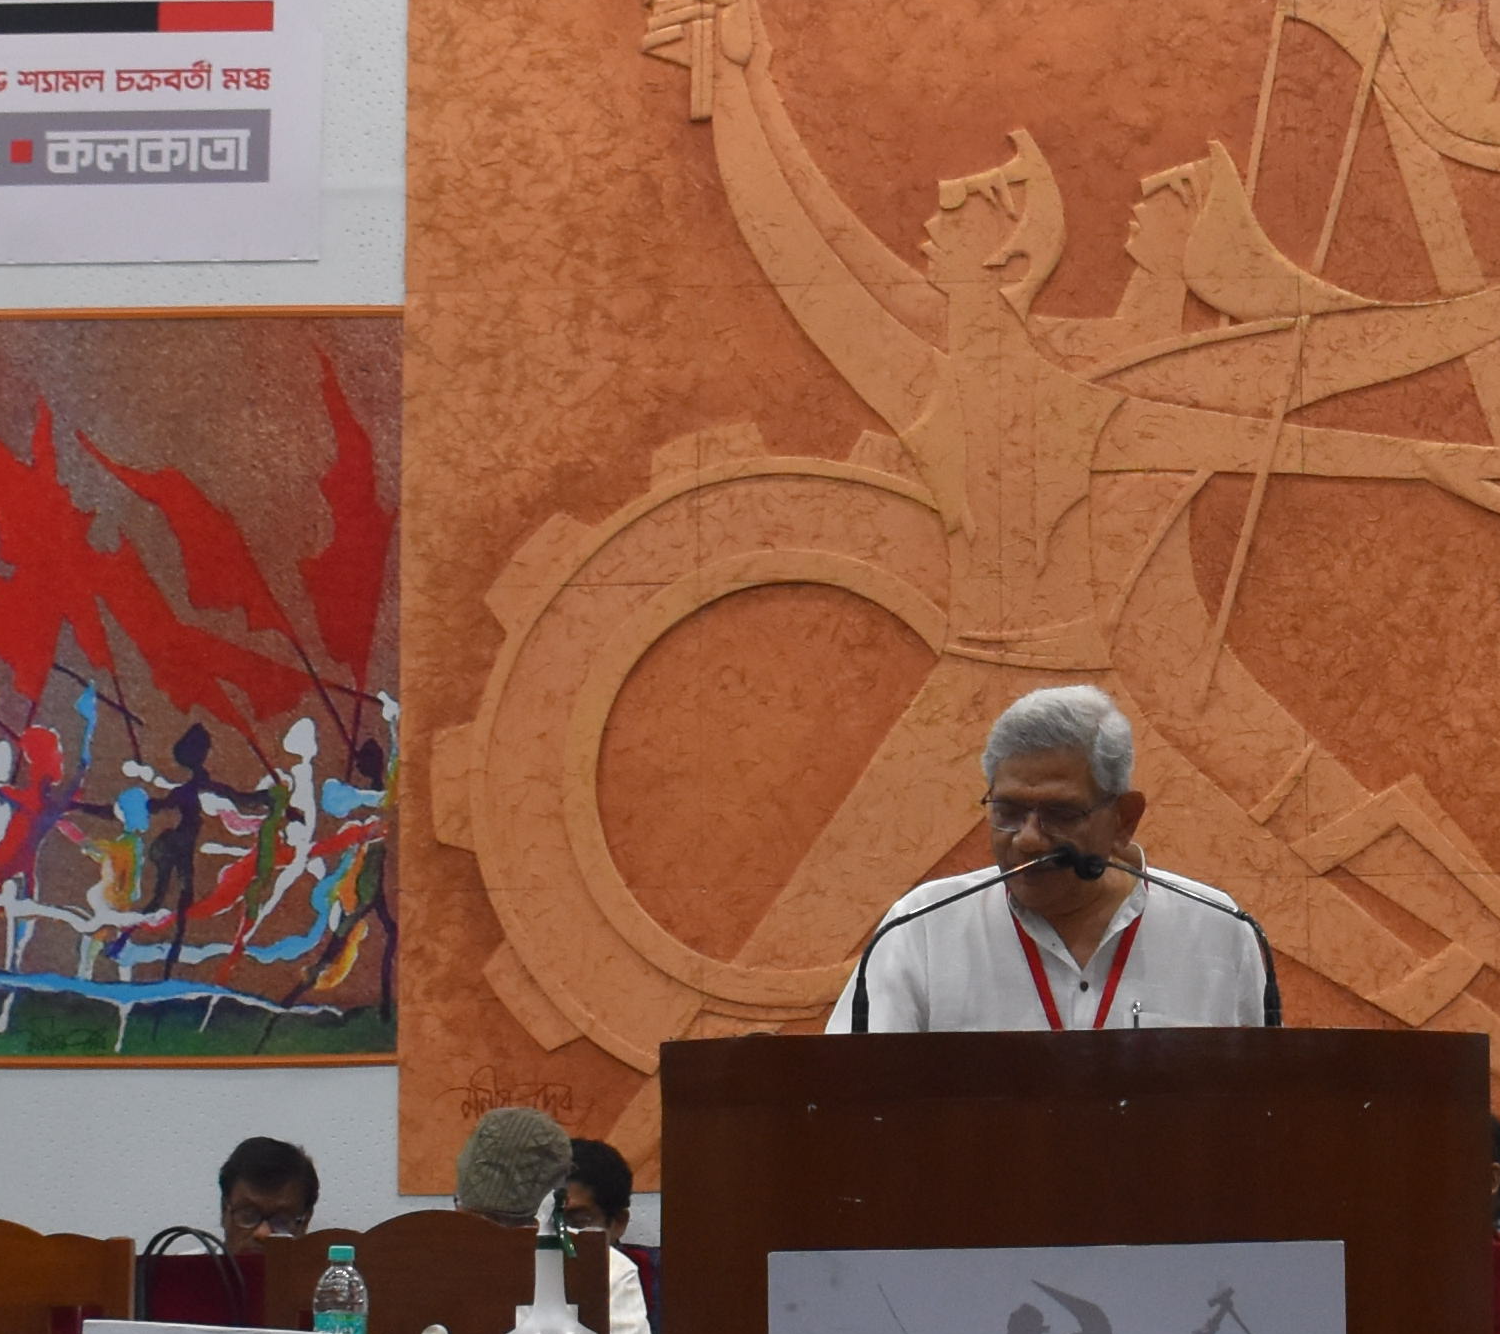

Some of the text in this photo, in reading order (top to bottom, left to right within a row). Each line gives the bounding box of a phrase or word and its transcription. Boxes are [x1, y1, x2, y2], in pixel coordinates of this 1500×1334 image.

[18, 69, 104, 93] শ্যামল
[116, 60, 212, 92] চক্রবর্তী
[222, 67, 271, 91] মঞ্চ
[45, 129, 250, 175] কলকাতা
